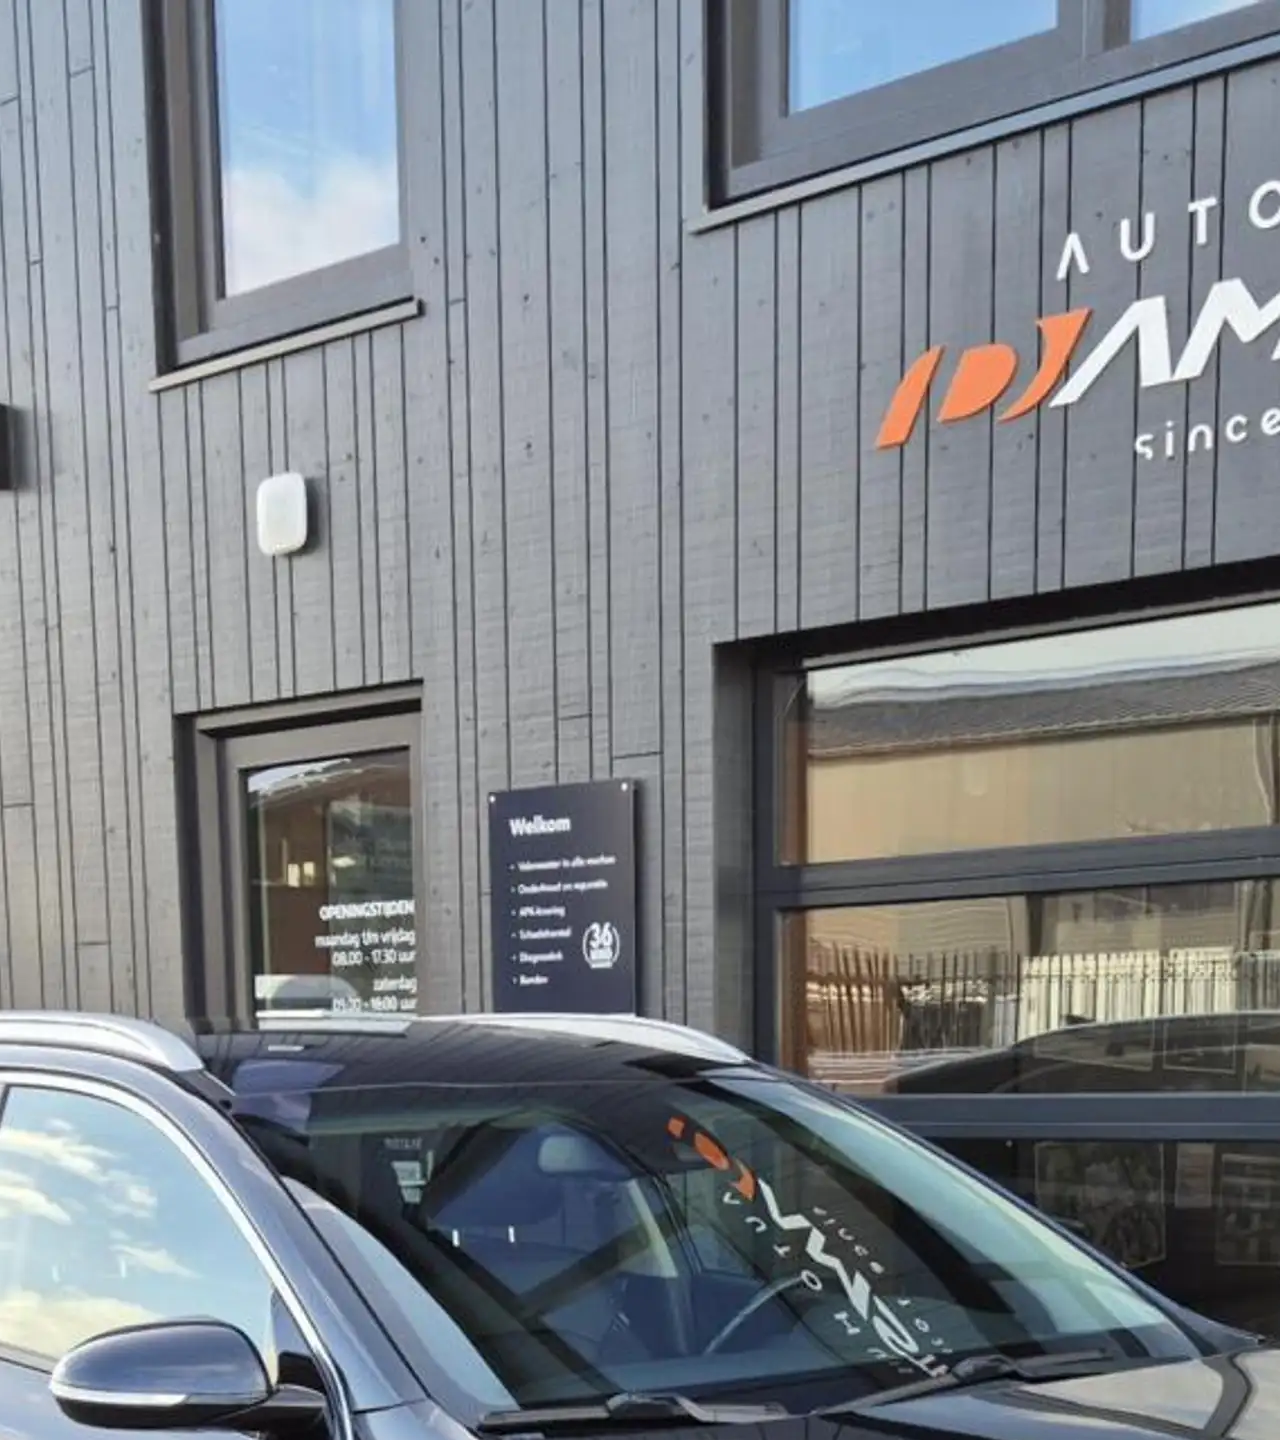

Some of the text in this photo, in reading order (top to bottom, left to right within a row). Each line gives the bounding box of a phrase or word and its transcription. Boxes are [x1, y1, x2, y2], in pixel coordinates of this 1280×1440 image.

[509, 814, 572, 837] Welkom
[319, 900, 415, 921] OPENINGSTIJDEN
[314, 929, 360, 948] maandag
[381, 927, 415, 946] vrijdag
[589, 921, 614, 948] 36
[398, 949, 416, 962] uur
[373, 974, 418, 993] zaterdag
[400, 997, 418, 1010] uur
